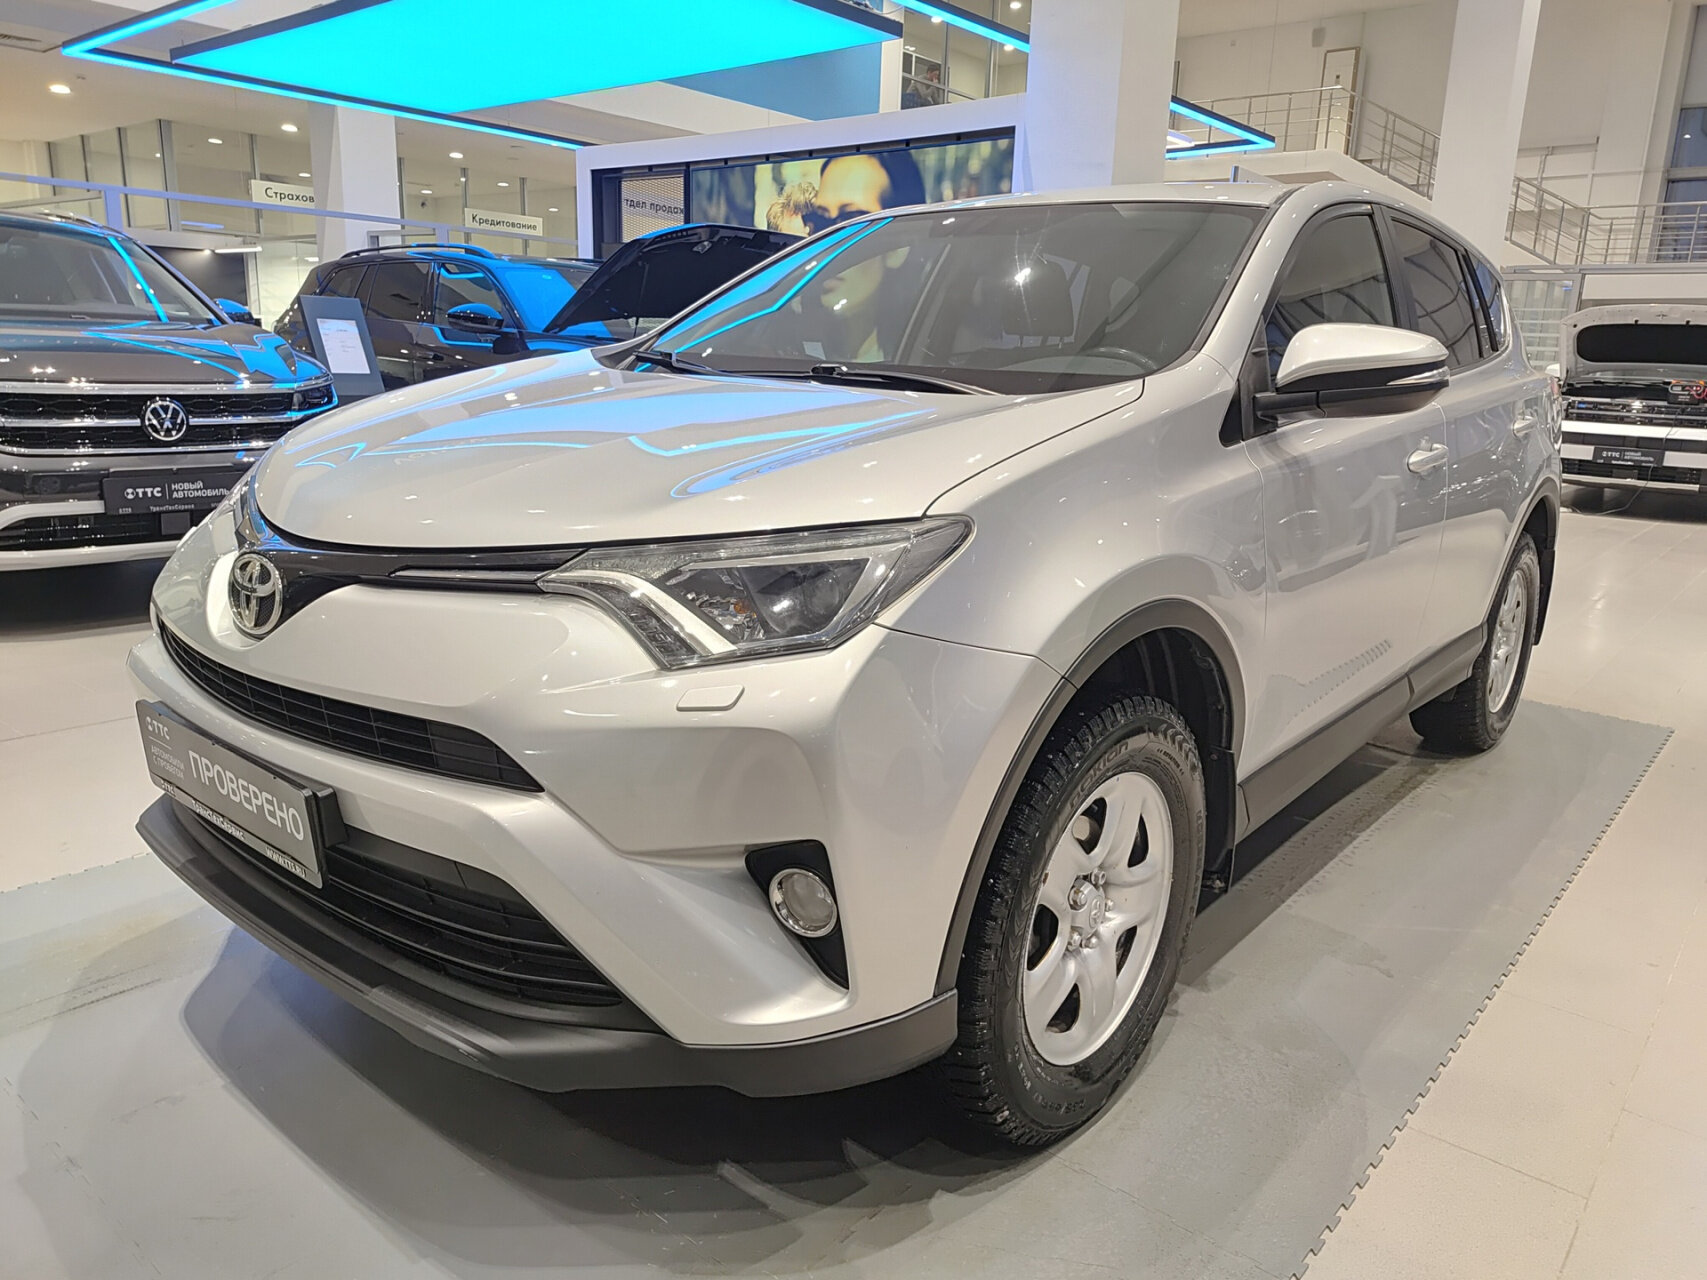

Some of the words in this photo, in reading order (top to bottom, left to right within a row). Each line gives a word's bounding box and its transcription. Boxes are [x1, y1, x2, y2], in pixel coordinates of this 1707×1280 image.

[471, 213, 537, 231] Кредитование
[171, 480, 204, 491] НОВЫЙ
[172, 488, 230, 499] АВТОМОБИЛЬ
[188, 750, 304, 841] ПРОВЕРЕНО
